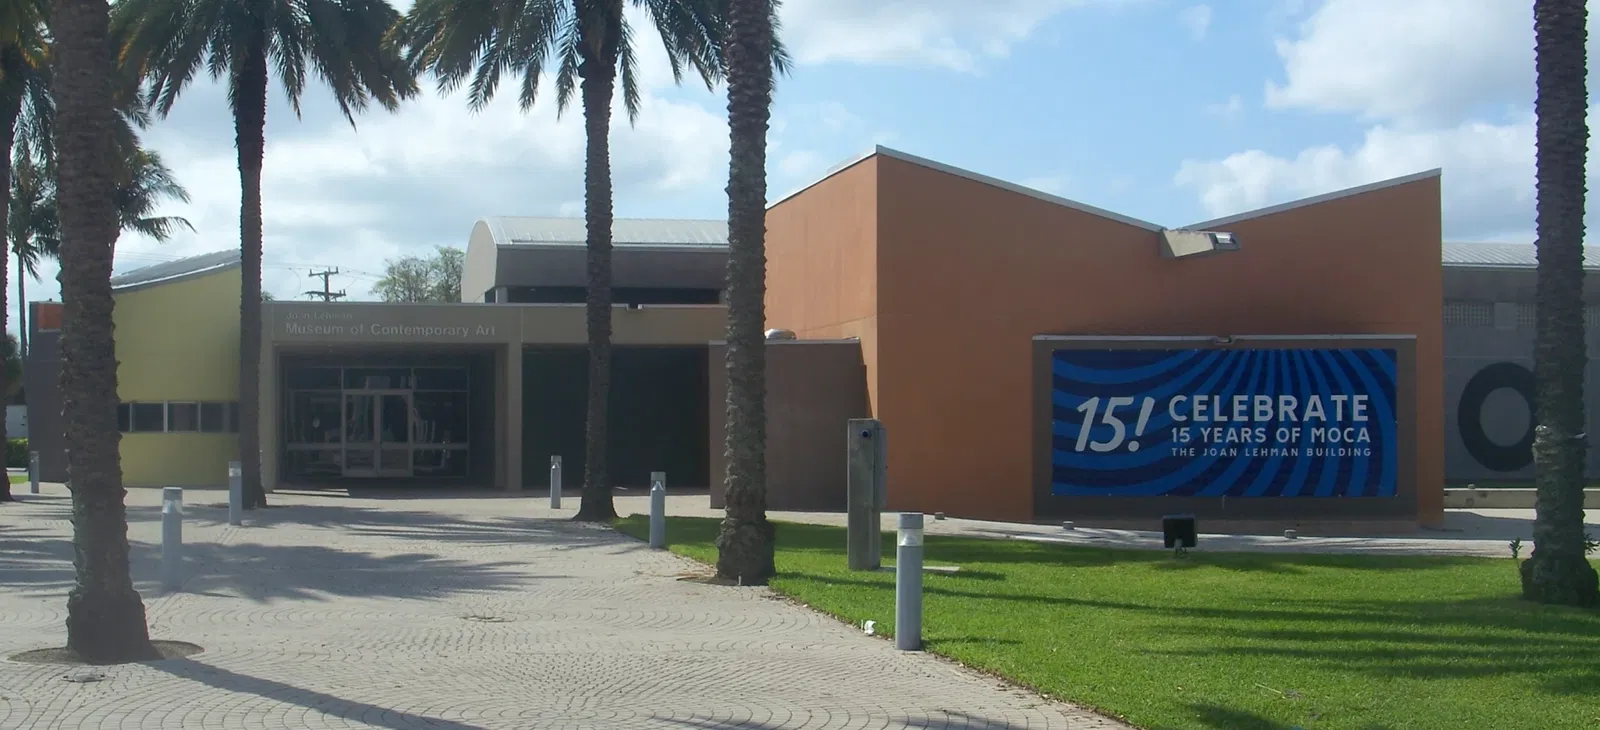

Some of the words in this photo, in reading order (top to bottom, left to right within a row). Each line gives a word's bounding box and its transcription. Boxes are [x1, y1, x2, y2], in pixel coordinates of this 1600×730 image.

[285, 311, 310, 321] Joan
[285, 321, 344, 335] Museum
[350, 323, 364, 335] of
[370, 323, 469, 338] Contemporary
[475, 324, 496, 336] Art
[1169, 395, 1369, 422] CELEBRATE
[1075, 396, 1156, 453] 15!
[1171, 427, 1190, 443] 15
[1200, 427, 1266, 443] YEARS
[1275, 427, 1301, 443] OF
[1311, 427, 1371, 443] MOCA
[1171, 447, 1196, 457] THE
[1203, 447, 1237, 457] JOAN
[1245, 447, 1299, 457] LEHMAN
[1306, 447, 1372, 457] BUILDING
